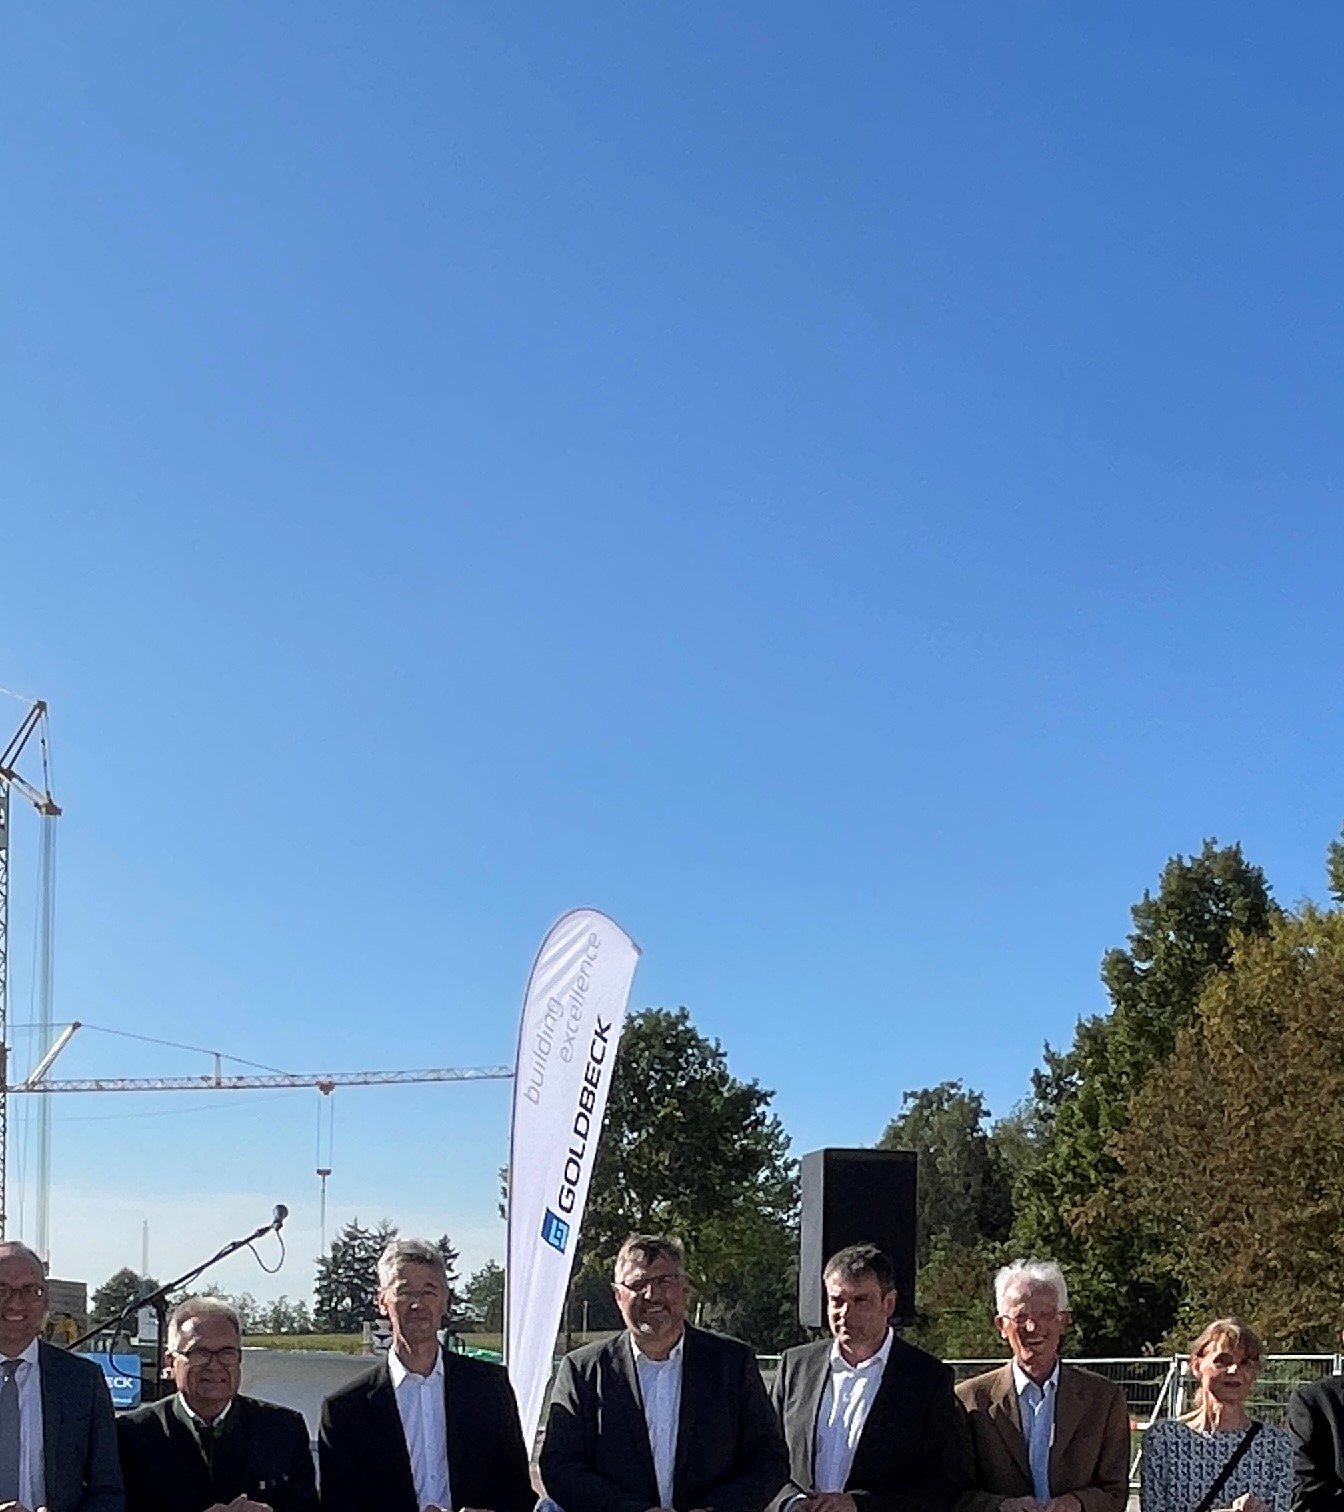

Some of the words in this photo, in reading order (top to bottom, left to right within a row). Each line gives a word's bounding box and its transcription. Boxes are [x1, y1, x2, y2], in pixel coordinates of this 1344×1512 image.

[524, 996, 564, 1104] building
[560, 931, 602, 1063] excellence
[558, 1013, 612, 1214] GOLDBECK
